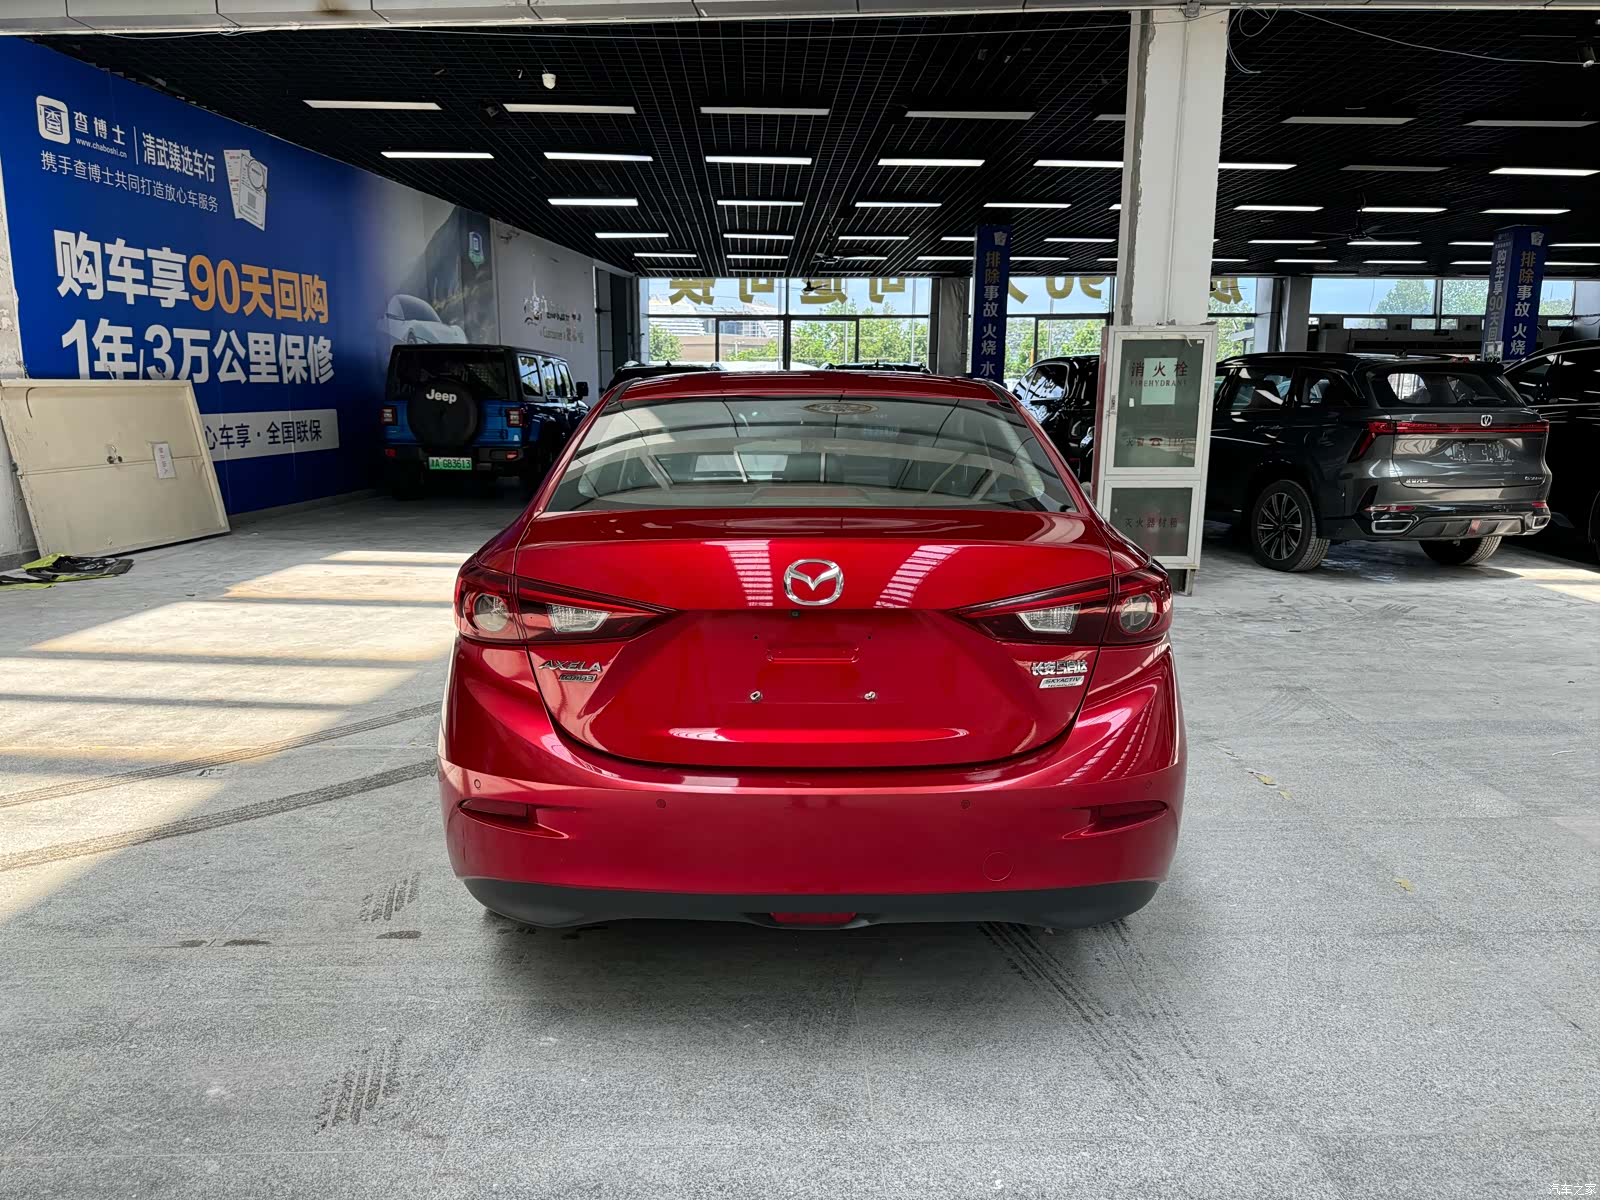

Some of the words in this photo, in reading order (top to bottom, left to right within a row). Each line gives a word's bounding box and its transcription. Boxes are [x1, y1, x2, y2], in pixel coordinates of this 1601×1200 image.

[74, 111, 126, 146] 查博士
[75, 137, 127, 158] www.chaboshi.cn
[142, 132, 216, 183] 清武臻选车行
[40, 150, 219, 213] 携手查博士共同打造放心车服务
[53, 229, 329, 324] 购车享90天回购
[983, 251, 1000, 317] 排除事故
[1514, 250, 1536, 318] 排除事故
[1131, 361, 1188, 377] 消火栓
[426, 389, 457, 404] Jeep
[539, 660, 603, 672] AXELA
